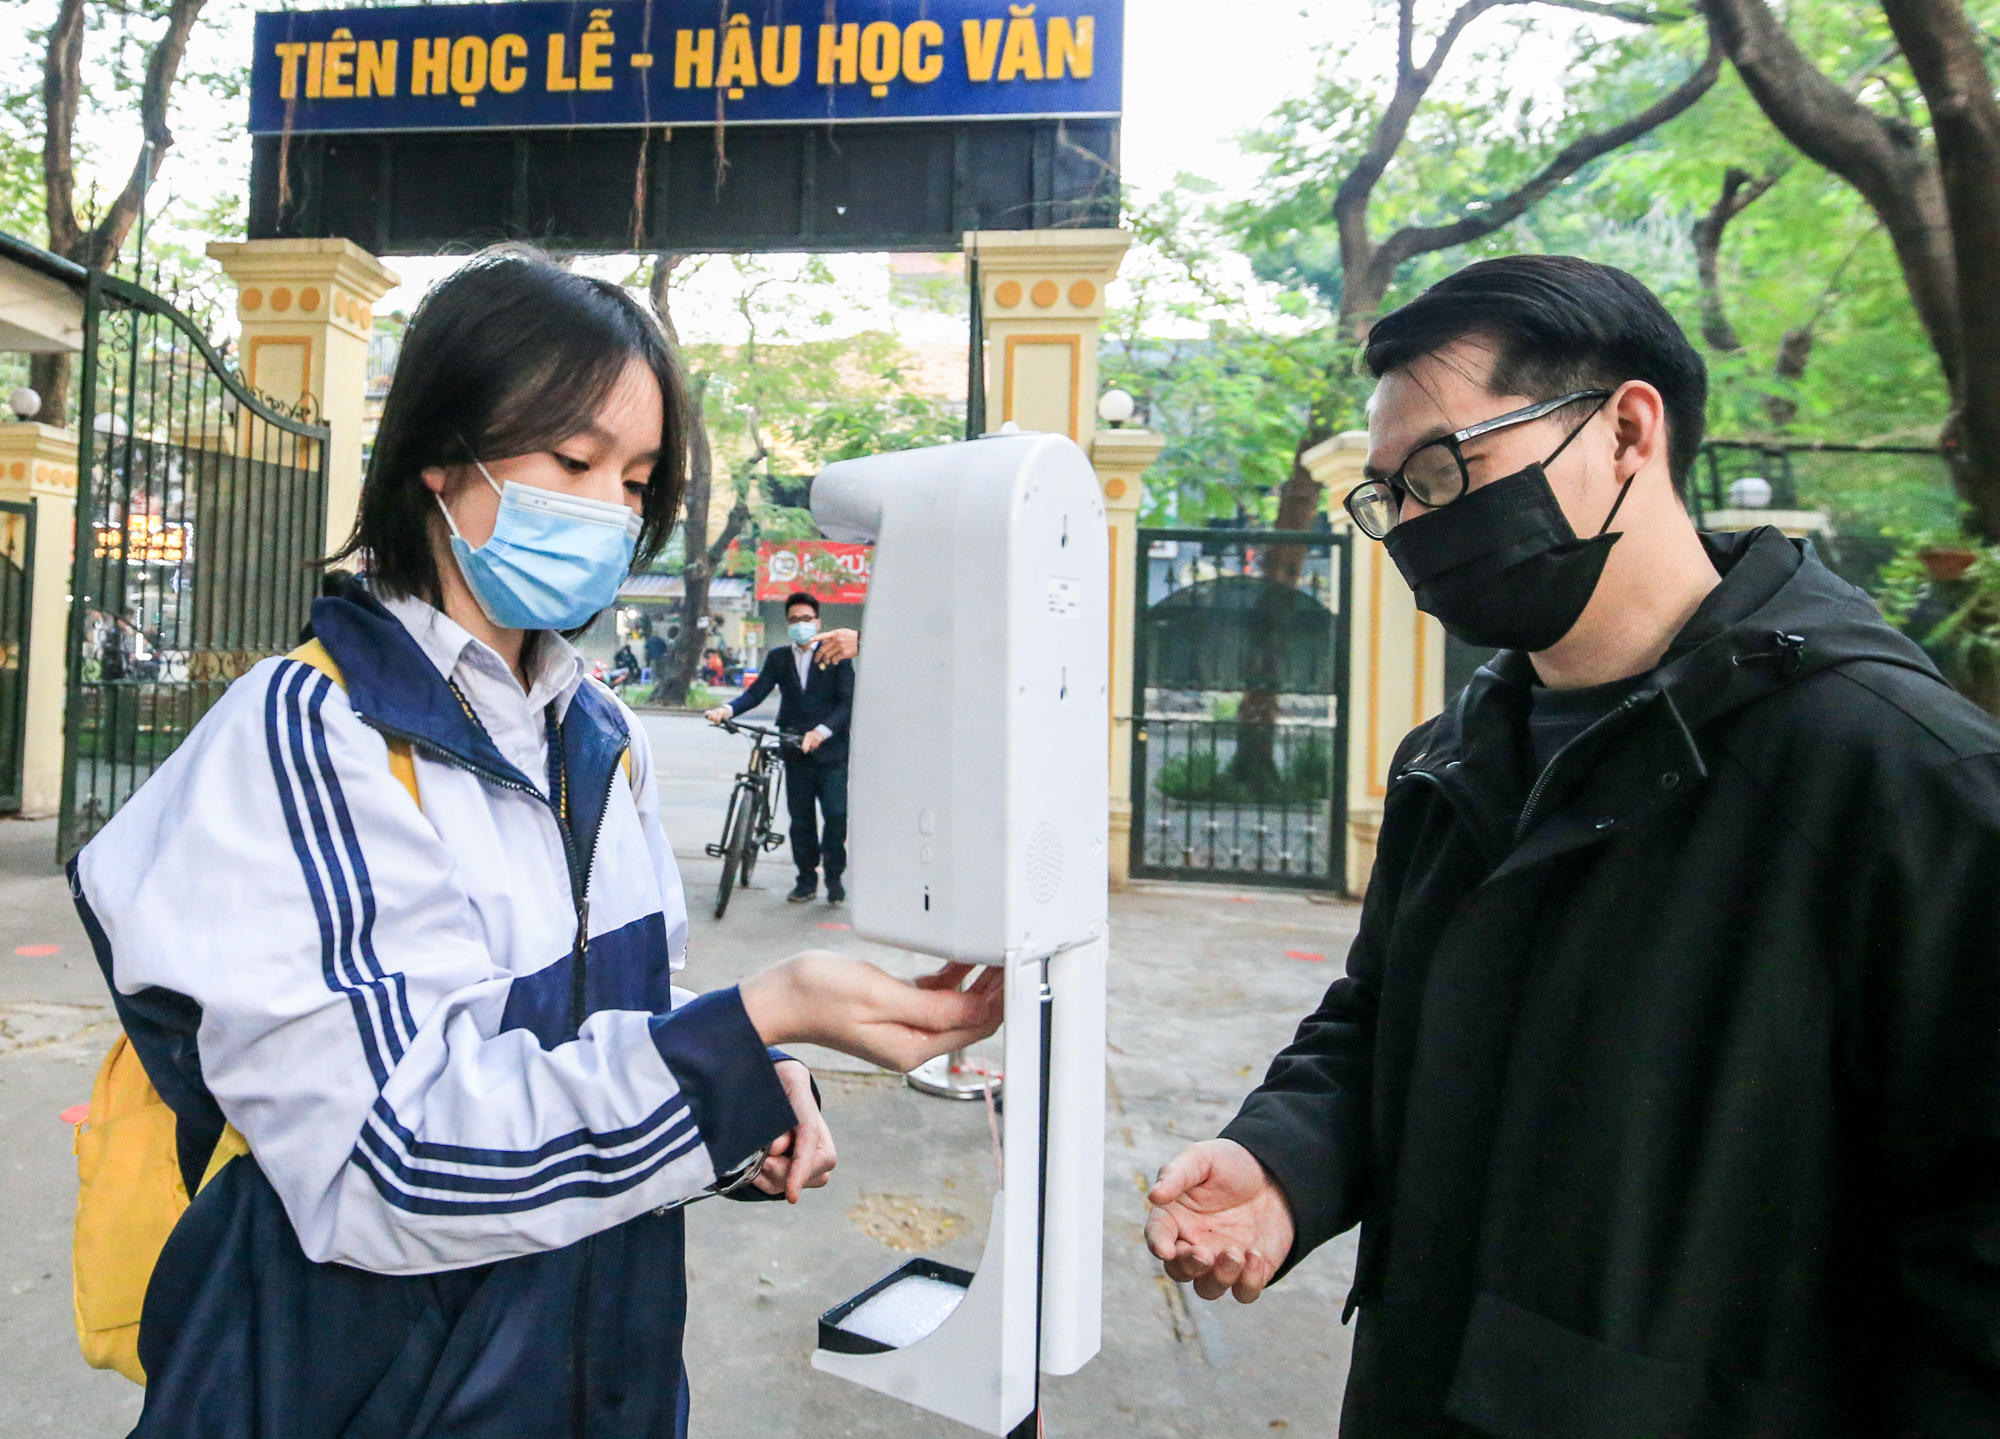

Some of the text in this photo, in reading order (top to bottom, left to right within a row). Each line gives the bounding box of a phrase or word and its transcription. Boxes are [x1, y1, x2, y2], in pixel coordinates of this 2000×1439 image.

[274, 4, 1095, 107] TIÊN HỌC LỄ - HẬU HỌC VĂN
